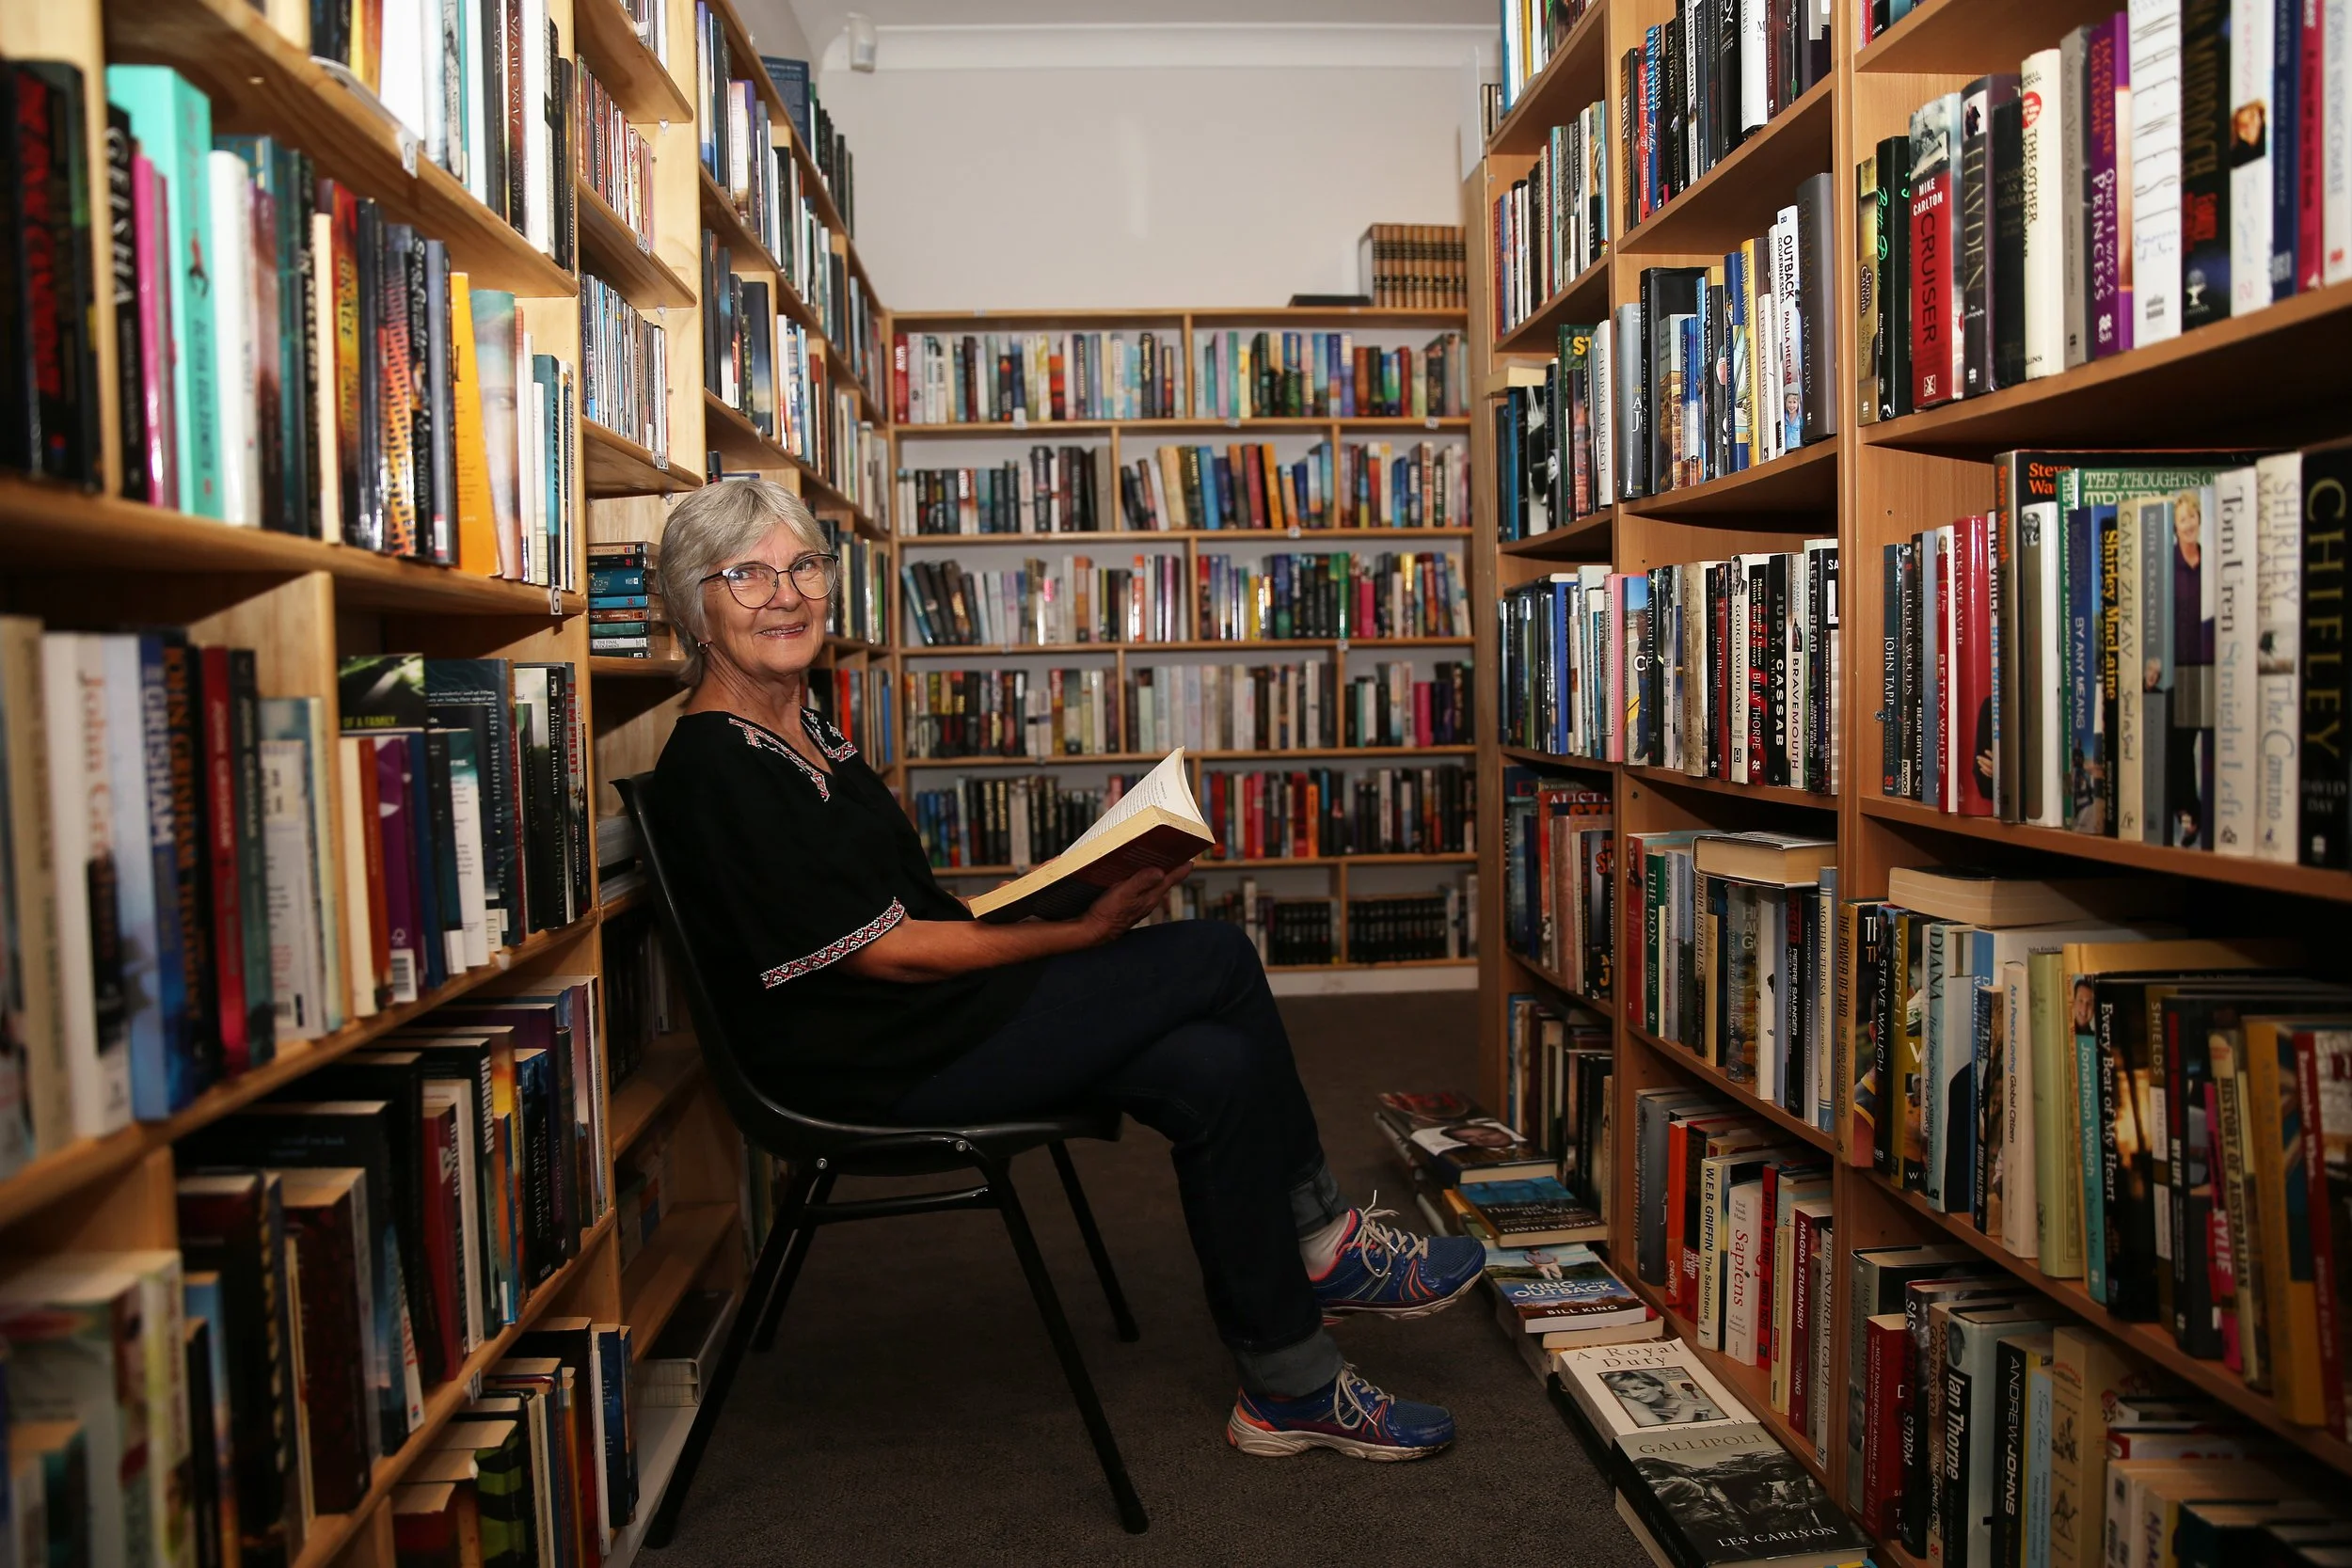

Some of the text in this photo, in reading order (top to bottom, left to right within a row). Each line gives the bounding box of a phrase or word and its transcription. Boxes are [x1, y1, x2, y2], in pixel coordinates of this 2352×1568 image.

[1913, 191, 1944, 216] CARLTON
[1919, 178, 1935, 197] MIKE
[1963, 147, 1985, 292] HAYDEN
[2026, 161, 2038, 224] OTHER
[2105, 166, 2116, 212] ONCE
[1784, 234, 1794, 301] OUTBACK
[2092, 171, 2106, 302] PRINCESS
[2106, 240, 2115, 277] WAS
[1920, 212, 1938, 345] CRUISER
[2085, 471, 2200, 490] THE THOUGHTS
[1955, 532, 1963, 578] JACKI
[2220, 484, 2244, 633] Tom Uren
[2272, 478, 2298, 608] SHIRLEY
[2106, 530, 2119, 700] Shirley MacLaine
[2121, 511, 2133, 658] GARY ZUKAV
[2306, 476, 2347, 760] CHIFLEY
[1809, 614, 1818, 653] DEAD
[1904, 590, 1914, 695] TIGER WOODS
[1775, 658, 1784, 746] CASSAB
[1884, 637, 1895, 705] JOHN TAPP
[2074, 616, 2086, 730] BY ANY MEANS
[566, 682, 579, 776] FILM PILOT
[1752, 673, 1761, 750] BILLY THORPE
[1791, 657, 1800, 769] BRAVEMOUTH
[1647, 870, 1657, 946] THE DON
[1695, 907, 1705, 973] AUSTRALIS
[1839, 914, 1850, 936] THE
[1838, 936, 1850, 975] POWER
[1929, 931, 1944, 1001] DIANA
[1837, 990, 1848, 1018] TWO
[1876, 958, 1887, 1071] STEVE WAUGH
[2101, 1003, 2114, 1053] Every
[2151, 1002, 2163, 1076] SHIELDS
[480, 1055, 495, 1156] HANGMAN
[2080, 1042, 2094, 1177] Jonathon Welch
[1704, 1167, 1715, 1252] W.E.B. GRIFFIN
[2105, 1153, 2117, 1202] Heart
[1502, 1225, 1546, 1233] DAVID
[1514, 1283, 1615, 1298] OUTBACK
[1523, 1280, 1576, 1291] KING
[1703, 1256, 1712, 1321] The Saboteurs
[1729, 1229, 1749, 1307] Sapiens
[1796, 1220, 1807, 1329] MAGDA SZUBANSKI
[1546, 1305, 1618, 1316] BILL KING
[1906, 1298, 1917, 1331] SAS
[1577, 1342, 1679, 1361] A Royal
[1602, 1356, 1667, 1368] Duty
[1946, 1372, 1965, 1481] Ian Thorpe
[2008, 1355, 2020, 1445] ANDREW
[1639, 1433, 1762, 1455] GALLIPOLI
[1902, 1412, 1915, 1466] STORM
[1931, 1474, 1941, 1536] HAMILTON
[2005, 1445, 2018, 1516] JOHNS
[1717, 1527, 1838, 1547] LES CARLYON
